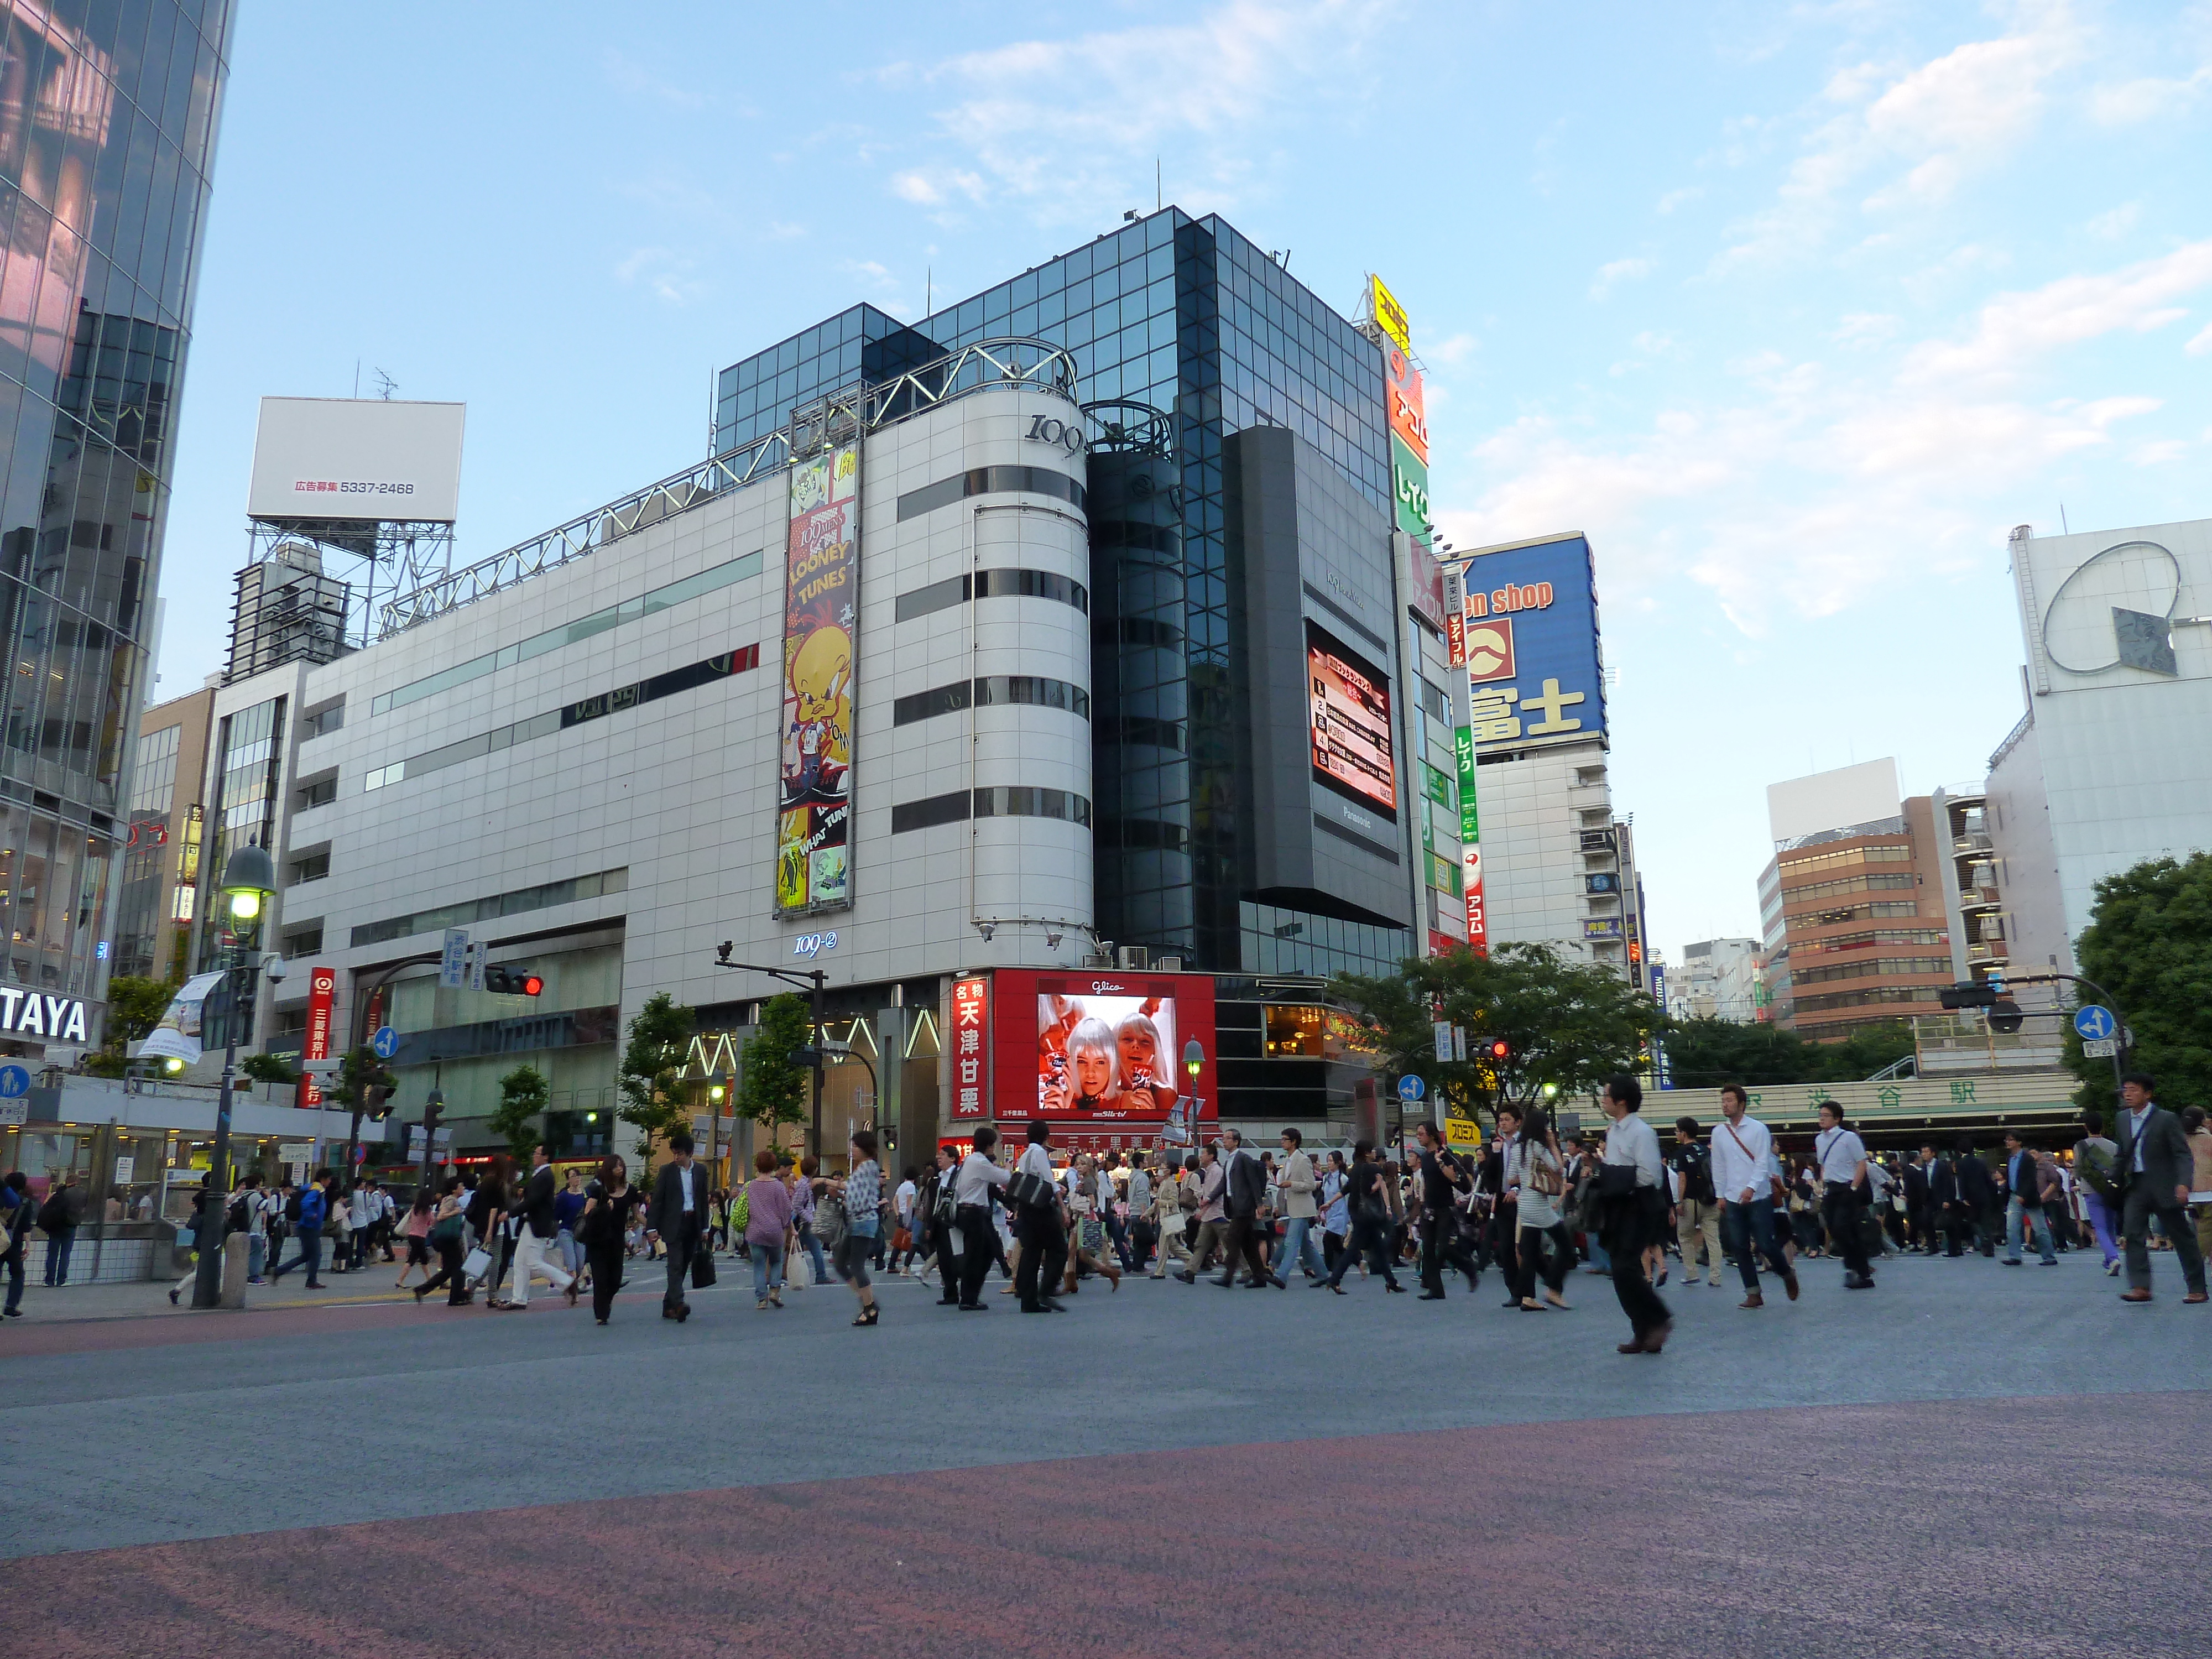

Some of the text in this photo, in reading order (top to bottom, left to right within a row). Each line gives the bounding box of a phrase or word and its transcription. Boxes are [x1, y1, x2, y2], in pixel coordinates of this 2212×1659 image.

[1396, 390, 1430, 449] アコム
[295, 481, 414, 494] 広告募集 5337-2468
[1395, 463, 1431, 524] レイク
[800, 515, 843, 548] 109 MEN'S
[790, 540, 850, 587] LOONEY
[799, 566, 846, 605] TUNES
[1413, 580, 1445, 626] アイフル
[1491, 582, 1553, 614] shop
[1449, 624, 1464, 664] アイフル
[1472, 678, 1585, 743] 富士
[1458, 737, 1472, 773] レイク
[1343, 806, 1371, 828] Panasonic
[799, 827, 826, 856] WHAT
[1467, 895, 1483, 934] アコム
[444, 941, 452, 963] Shibuya
[451, 935, 465, 984] 渋谷駅前
[956, 983, 983, 1000] 名物
[1092, 980, 1125, 995] Glico
[0, 987, 86, 1042] TAYA
[960, 1001, 979, 1114] 天津甘栗
[1068, 1136, 1164, 1149] 三千里薬品
[1451, 1123, 1475, 1141] プロミス
